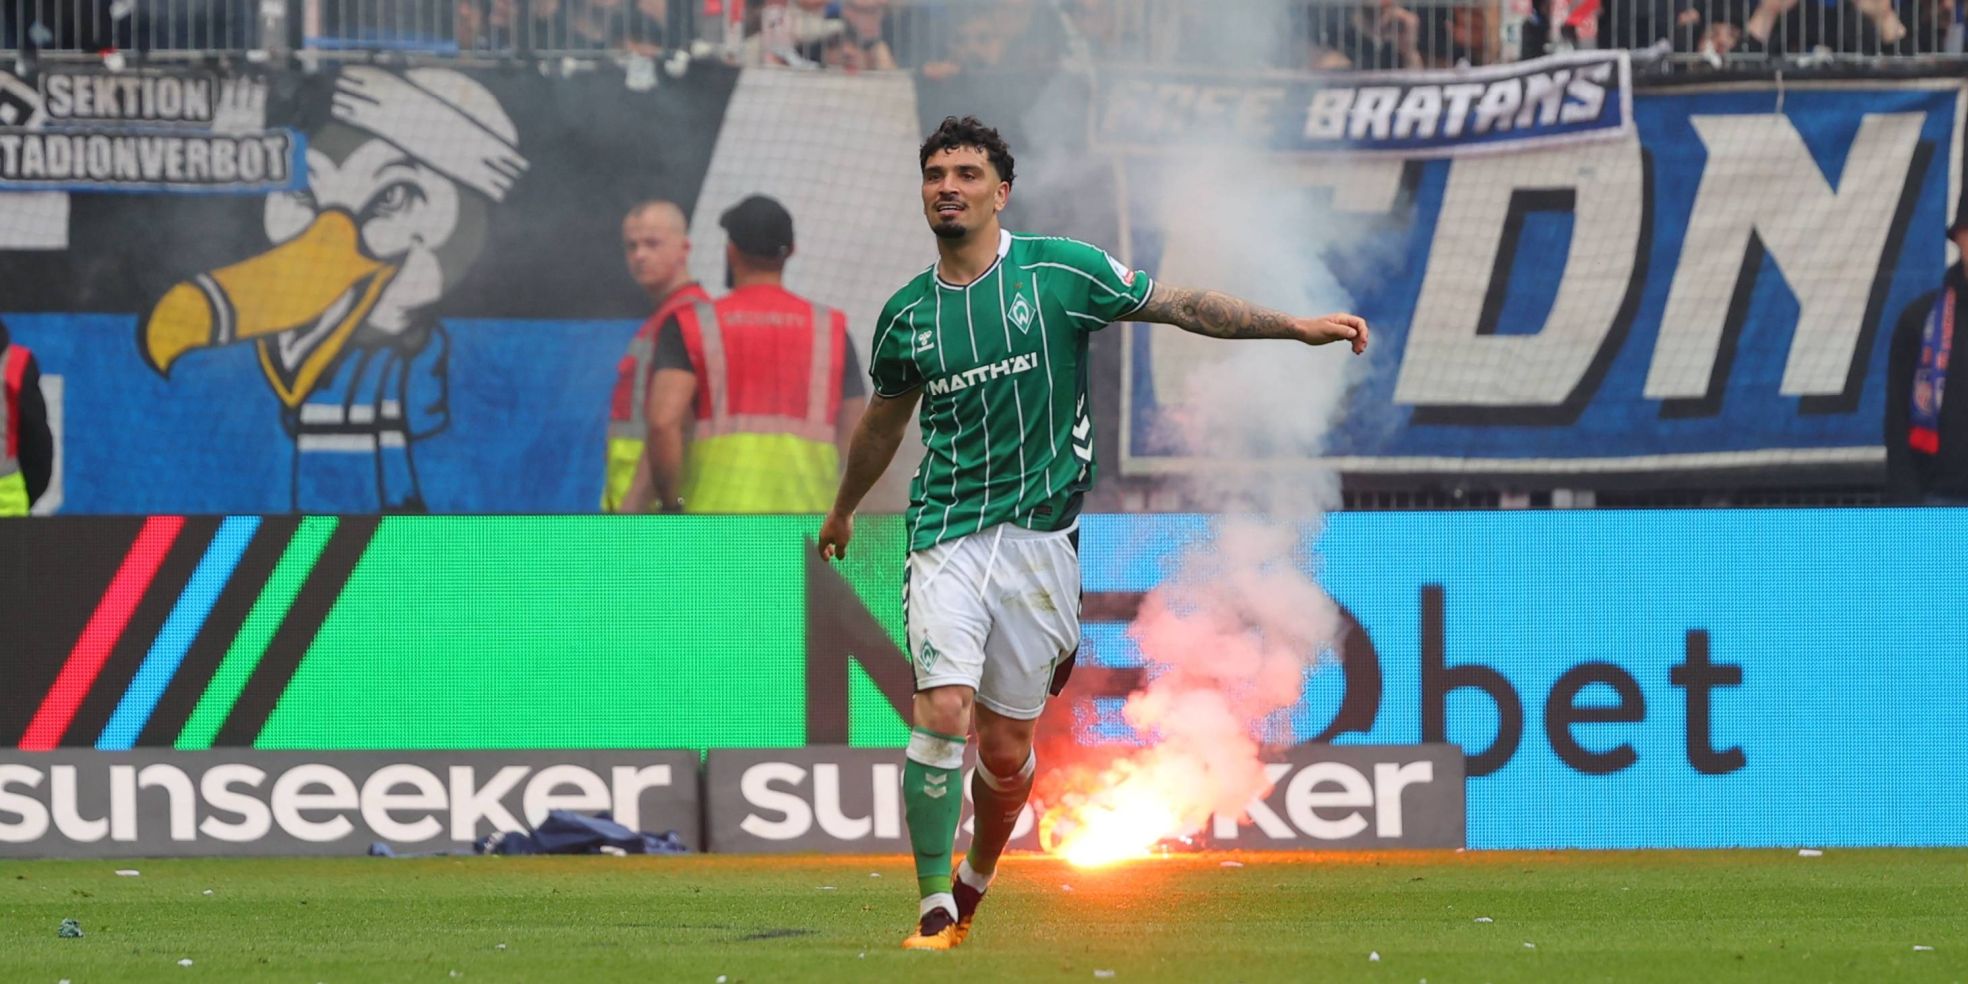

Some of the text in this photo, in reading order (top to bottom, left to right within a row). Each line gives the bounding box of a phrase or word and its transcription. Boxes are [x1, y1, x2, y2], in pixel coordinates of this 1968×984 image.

[46, 73, 212, 120] SEKTION
[1304, 62, 1613, 140] BRATANS
[928, 352, 1038, 396] MATTHÄI
[0, 763, 672, 842] sunseeker
[740, 761, 1433, 841] suker
